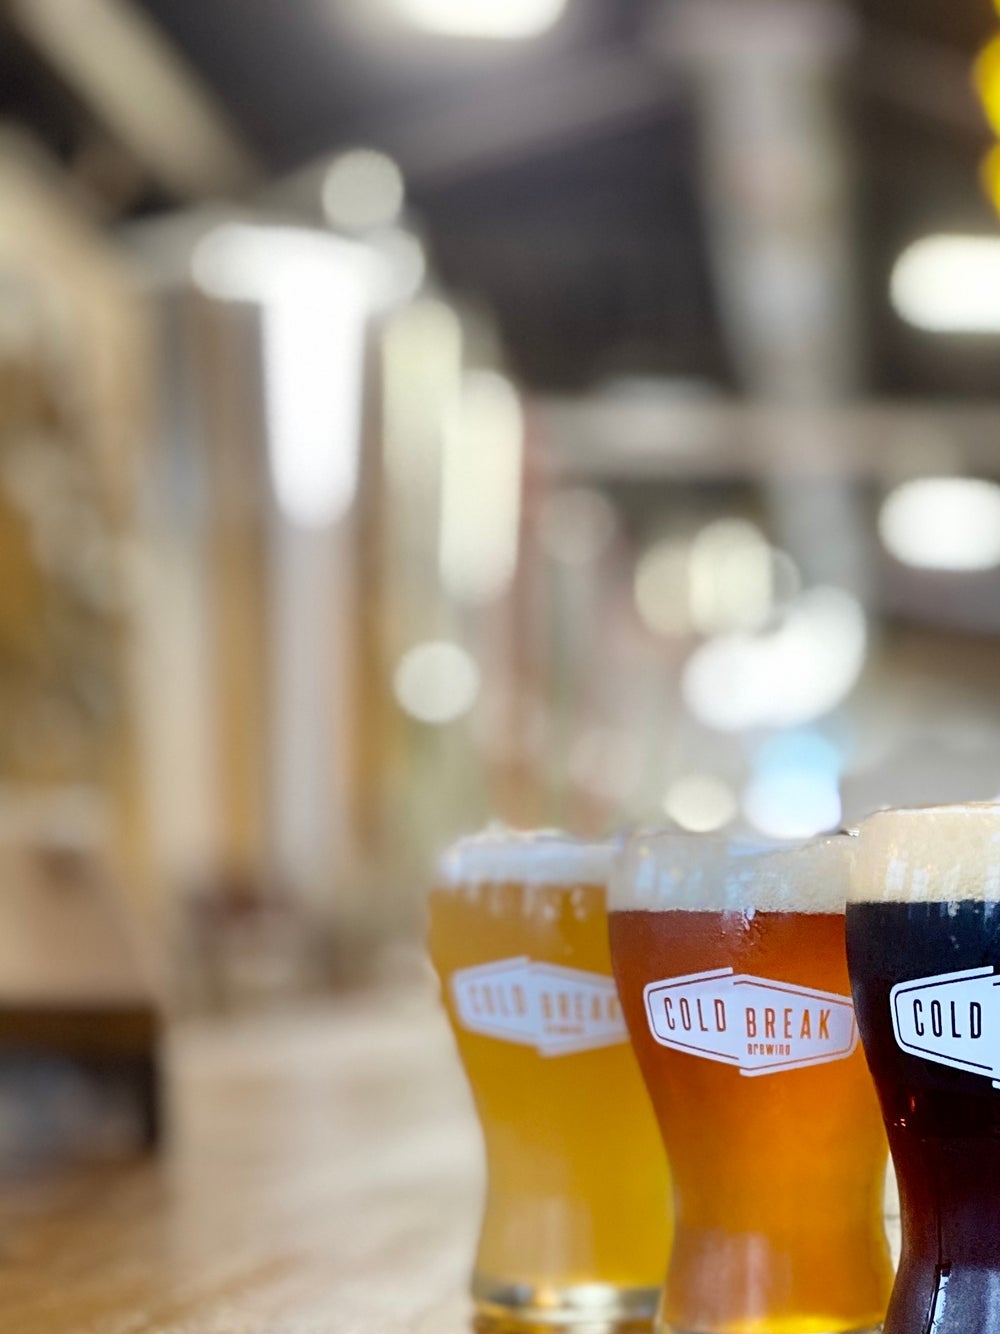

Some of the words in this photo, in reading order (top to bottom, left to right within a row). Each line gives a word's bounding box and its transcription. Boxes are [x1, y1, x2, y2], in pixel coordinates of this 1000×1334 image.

[664, 997, 727, 1032] COLD
[745, 1007, 831, 1040] BREAK
[912, 999, 982, 1039] COLD
